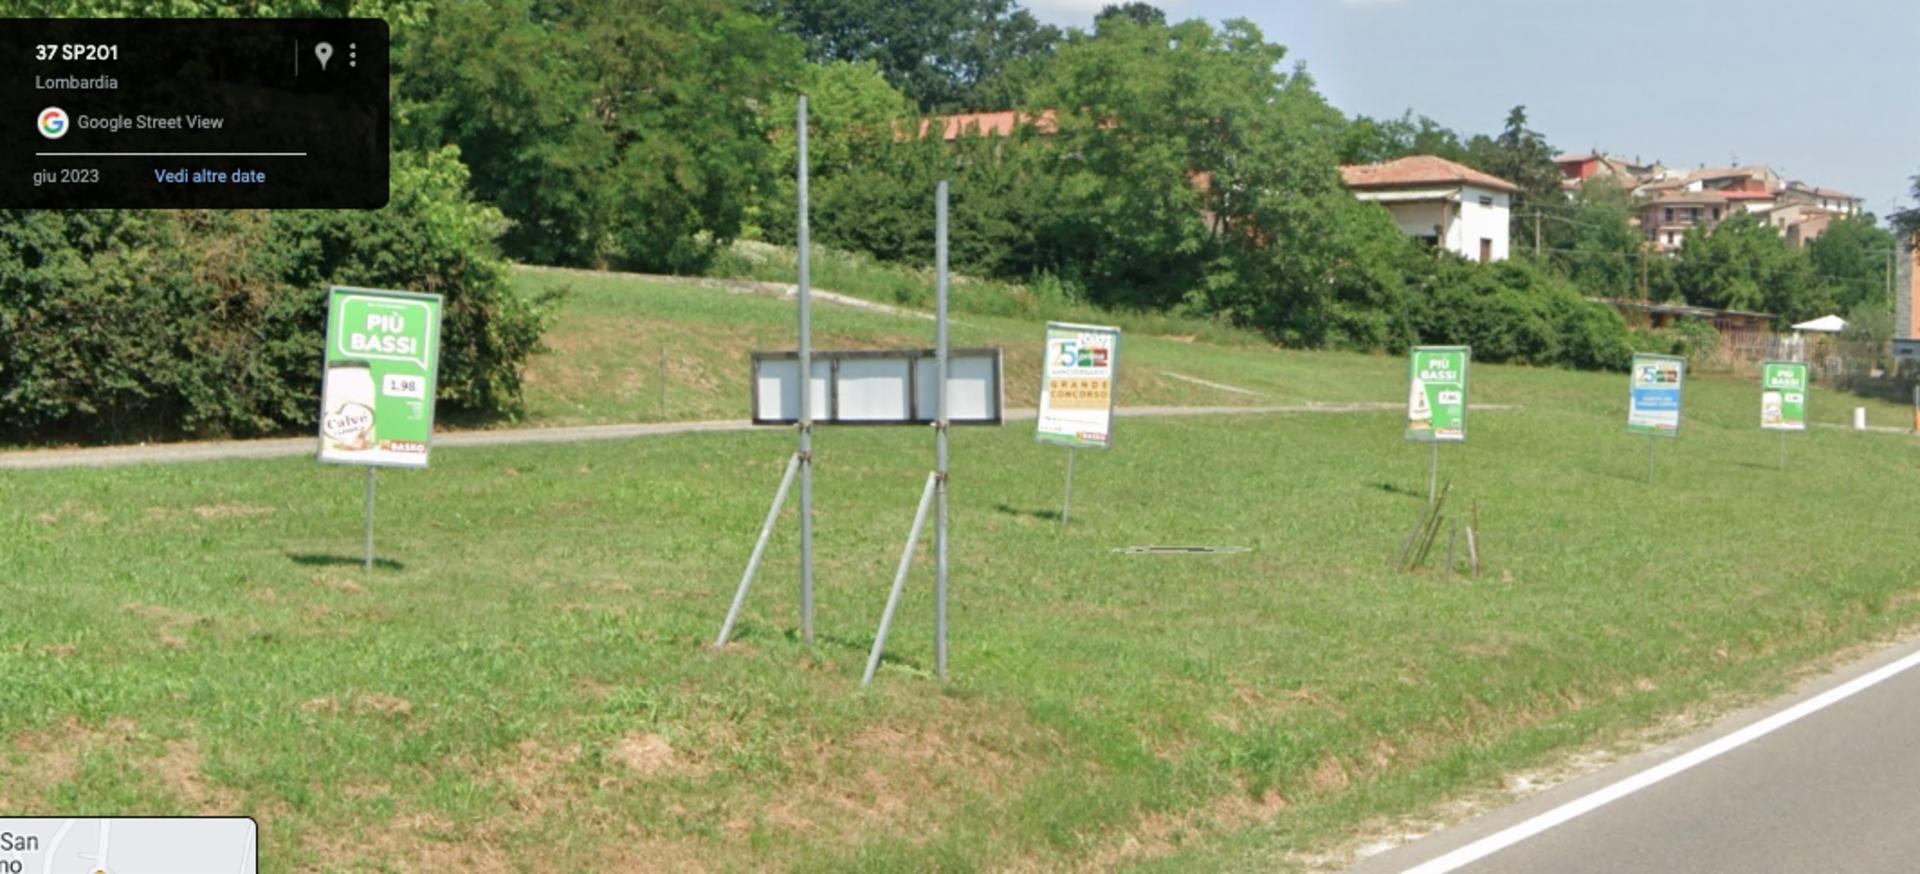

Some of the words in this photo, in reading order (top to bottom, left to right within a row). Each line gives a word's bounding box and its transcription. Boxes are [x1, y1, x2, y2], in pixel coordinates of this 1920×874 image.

[367, 312, 406, 333] PIÙ
[351, 333, 417, 353] BASSI
[1421, 370, 1457, 380] BASSI
[390, 379, 416, 392] 1.98
[1051, 380, 1108, 389] GRANDE
[1050, 390, 1108, 400] CONCORSO
